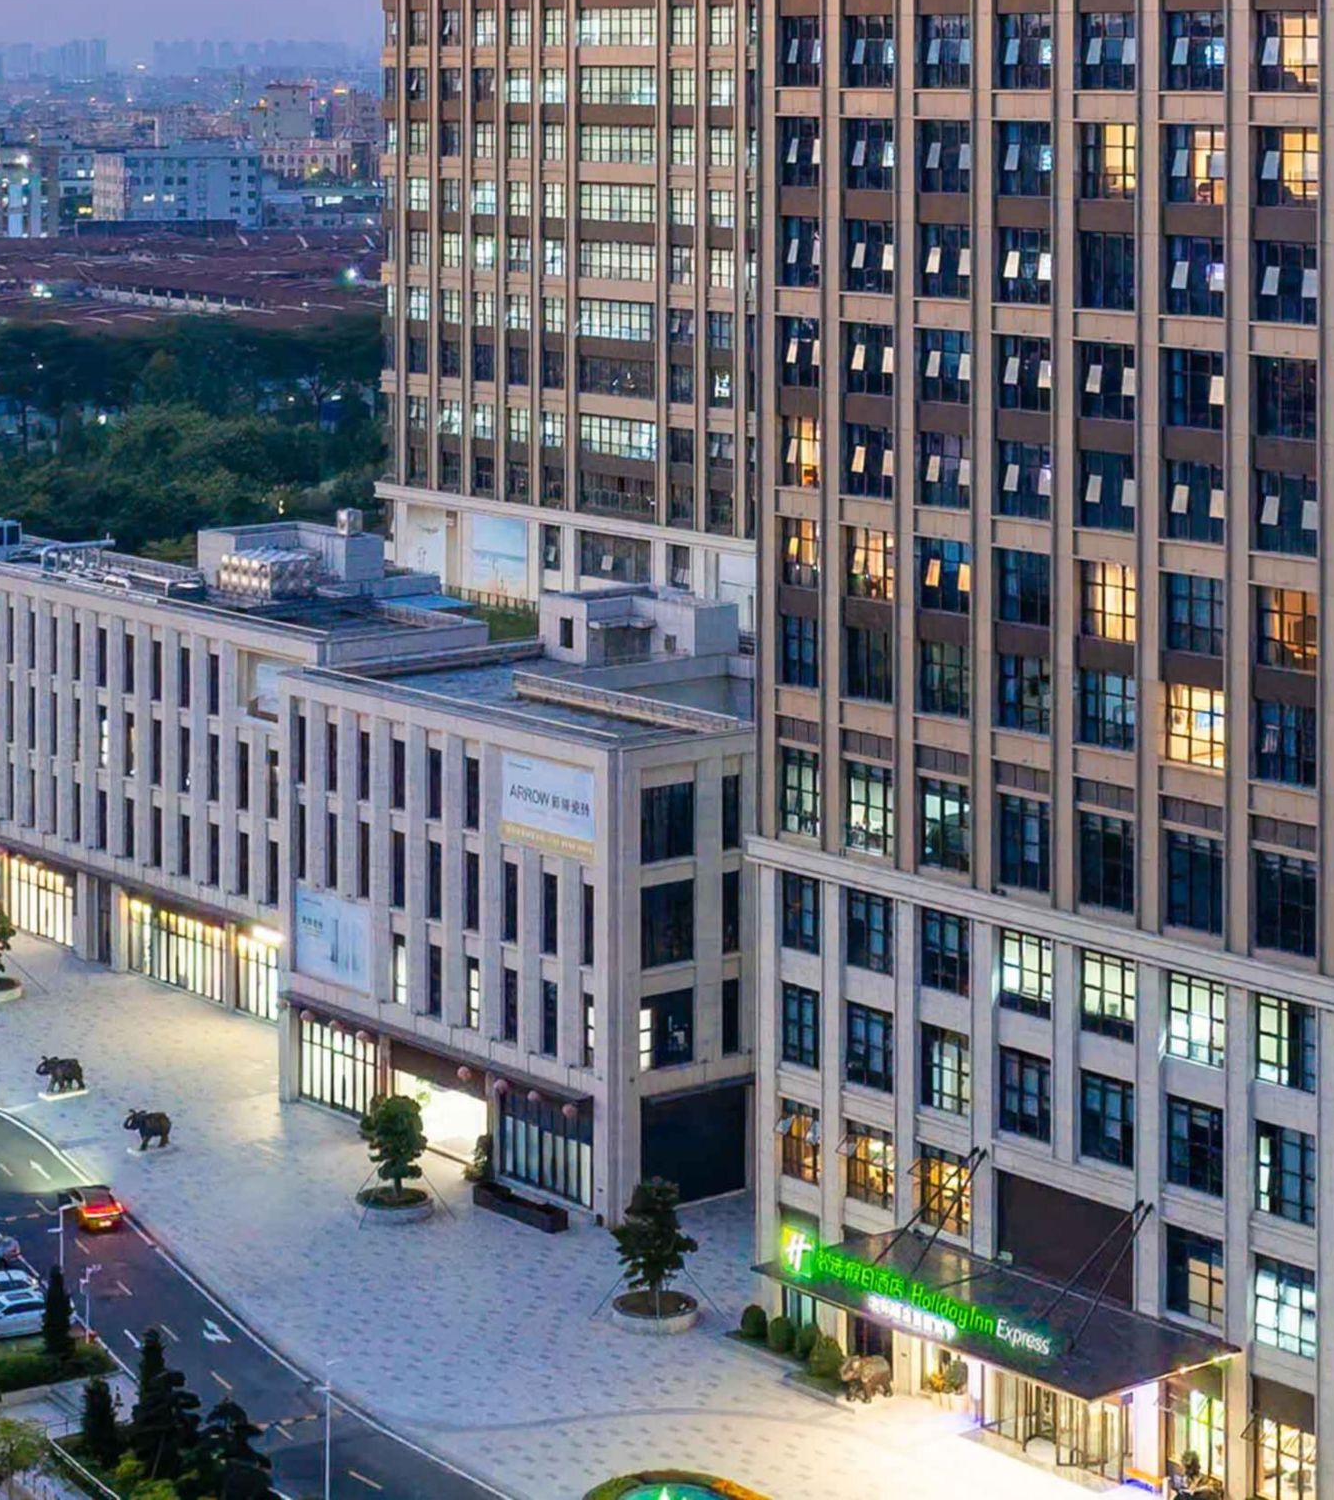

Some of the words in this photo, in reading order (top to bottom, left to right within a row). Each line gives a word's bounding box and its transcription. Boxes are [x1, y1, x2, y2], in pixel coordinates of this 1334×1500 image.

[509, 784, 550, 806] ARROW
[910, 1283, 967, 1330] Holiday
[970, 1306, 995, 1335] Inn
[995, 1317, 1051, 1355] Express
